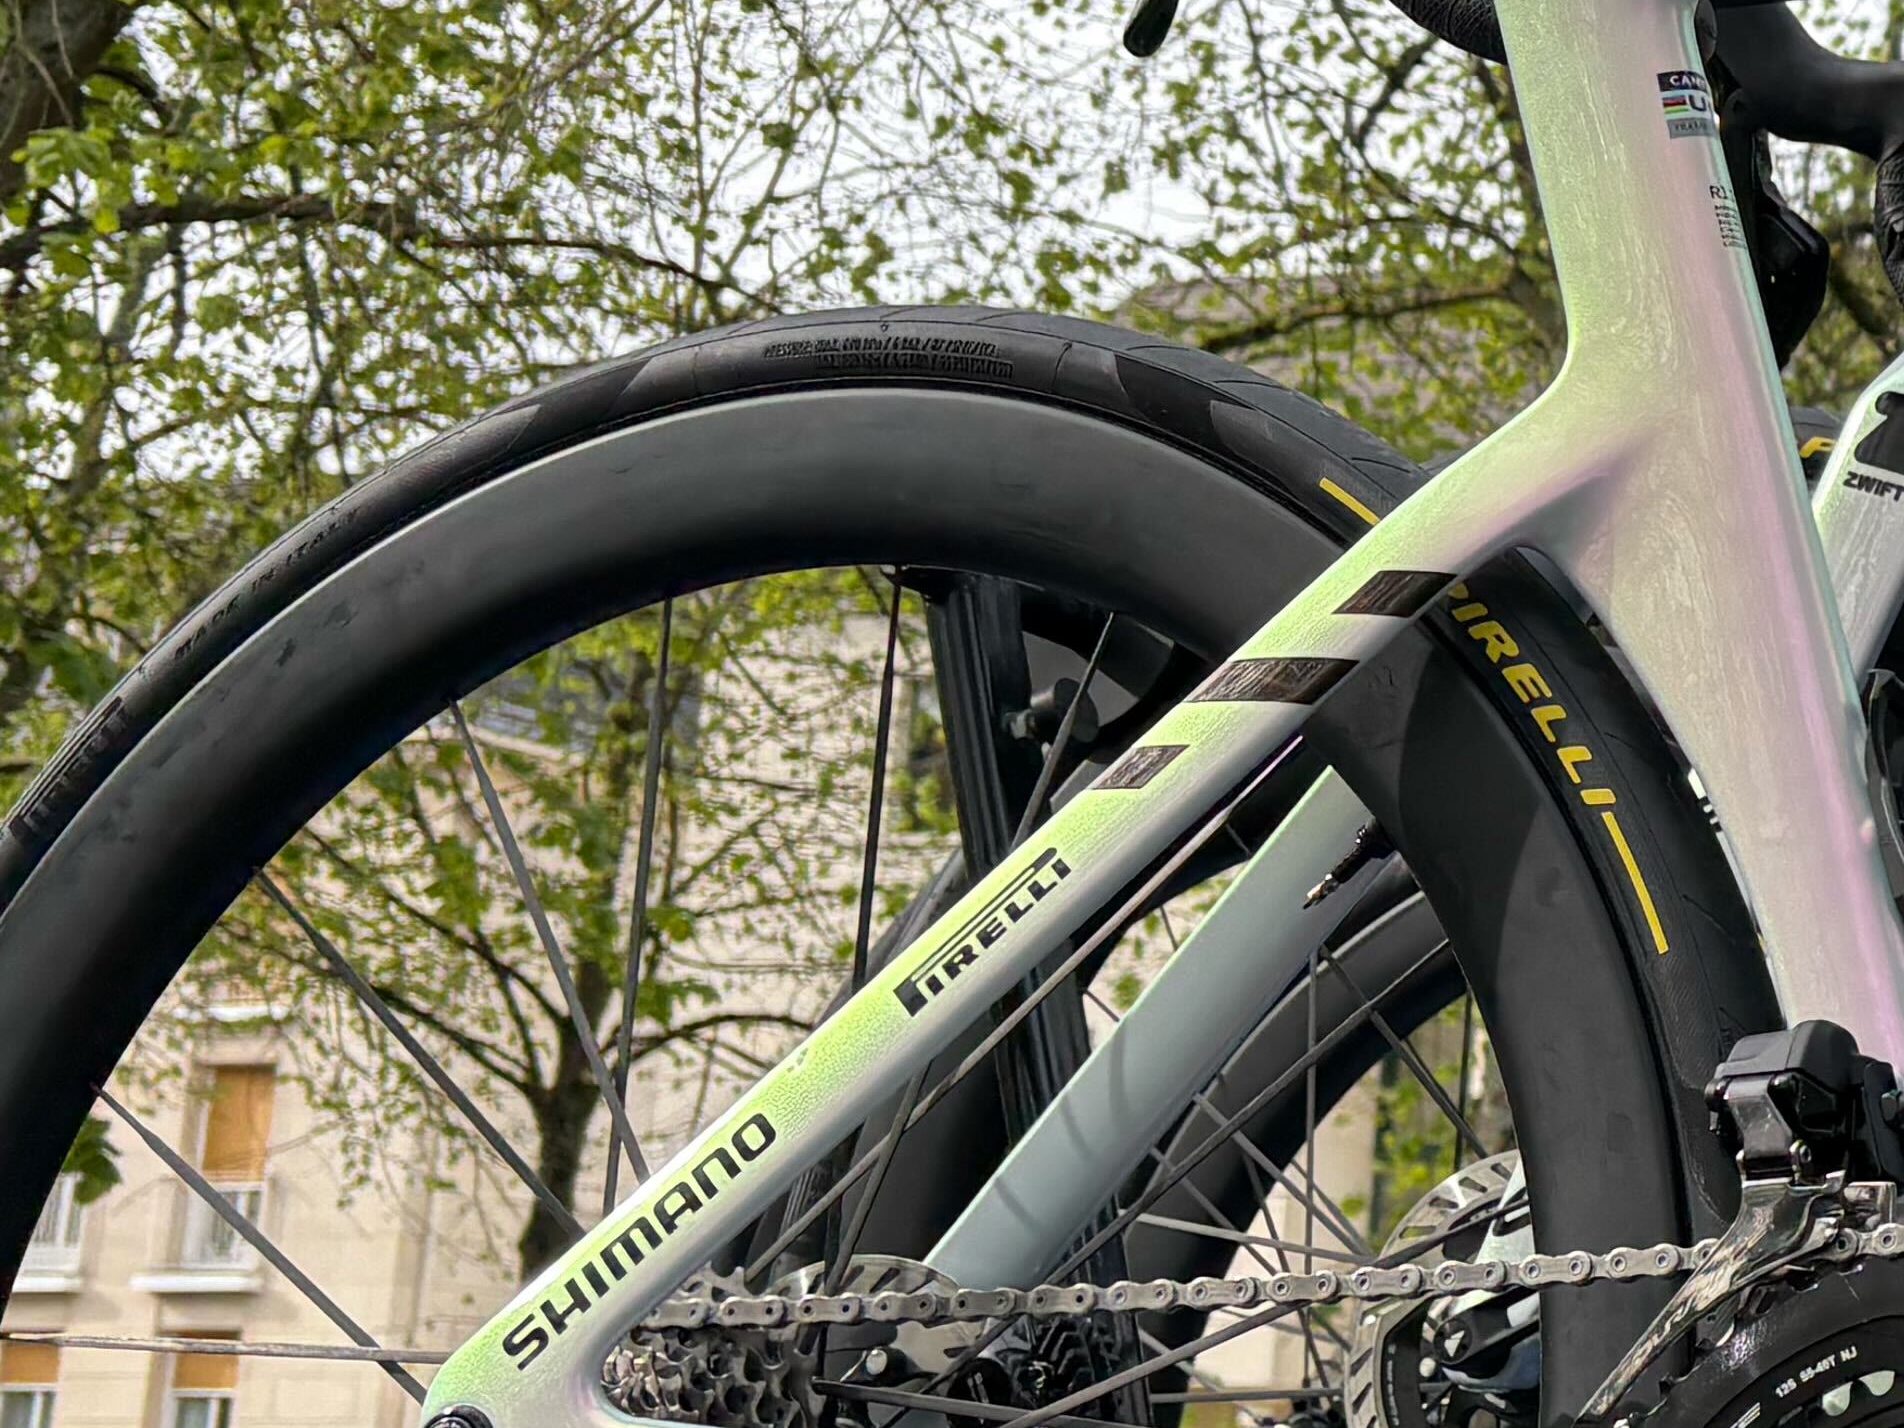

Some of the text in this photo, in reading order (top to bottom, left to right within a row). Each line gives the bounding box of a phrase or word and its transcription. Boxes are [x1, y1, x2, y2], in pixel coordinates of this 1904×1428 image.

[892, 846, 1073, 1018] PIRELLI
[502, 1112, 777, 1371] SHIMANO
[1840, 1345, 1859, 1363] NJ
